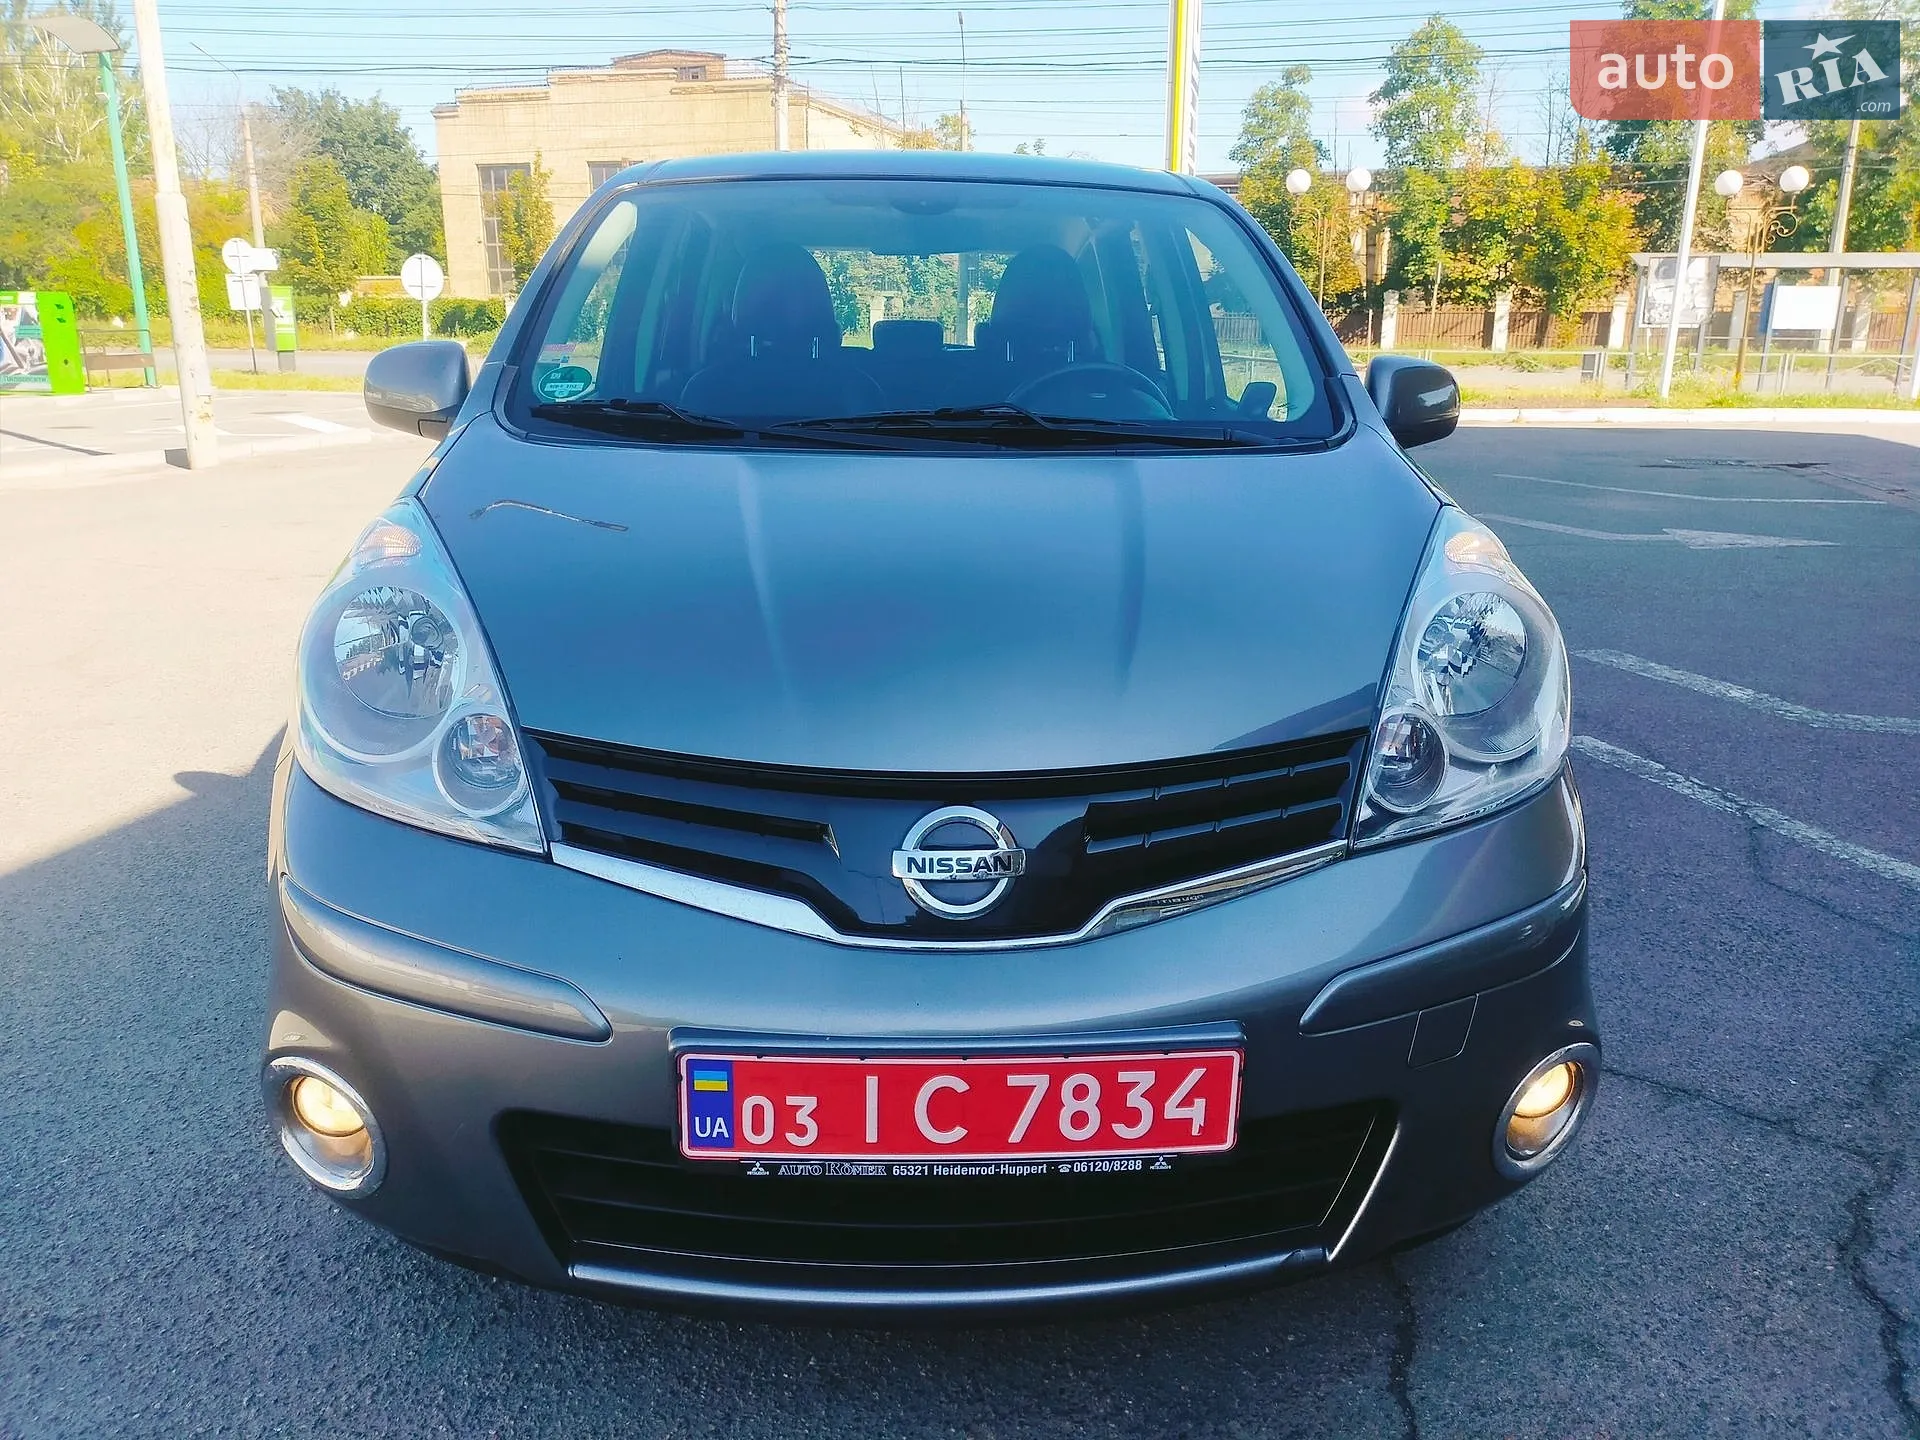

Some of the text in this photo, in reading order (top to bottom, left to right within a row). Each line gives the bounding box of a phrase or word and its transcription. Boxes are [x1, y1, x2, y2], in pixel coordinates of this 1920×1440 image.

[907, 855, 1012, 874] NISSAN
[741, 1095, 819, 1147] 03
[1006, 1067, 1208, 1144] 7834
[694, 1116, 729, 1138] UA
[777, 1164, 823, 1176] AUTO
[892, 1165, 929, 1176] 65321
[933, 1163, 1047, 1178] Heidenrod-Huppert
[1073, 1159, 1143, 1174] 06120/8288
